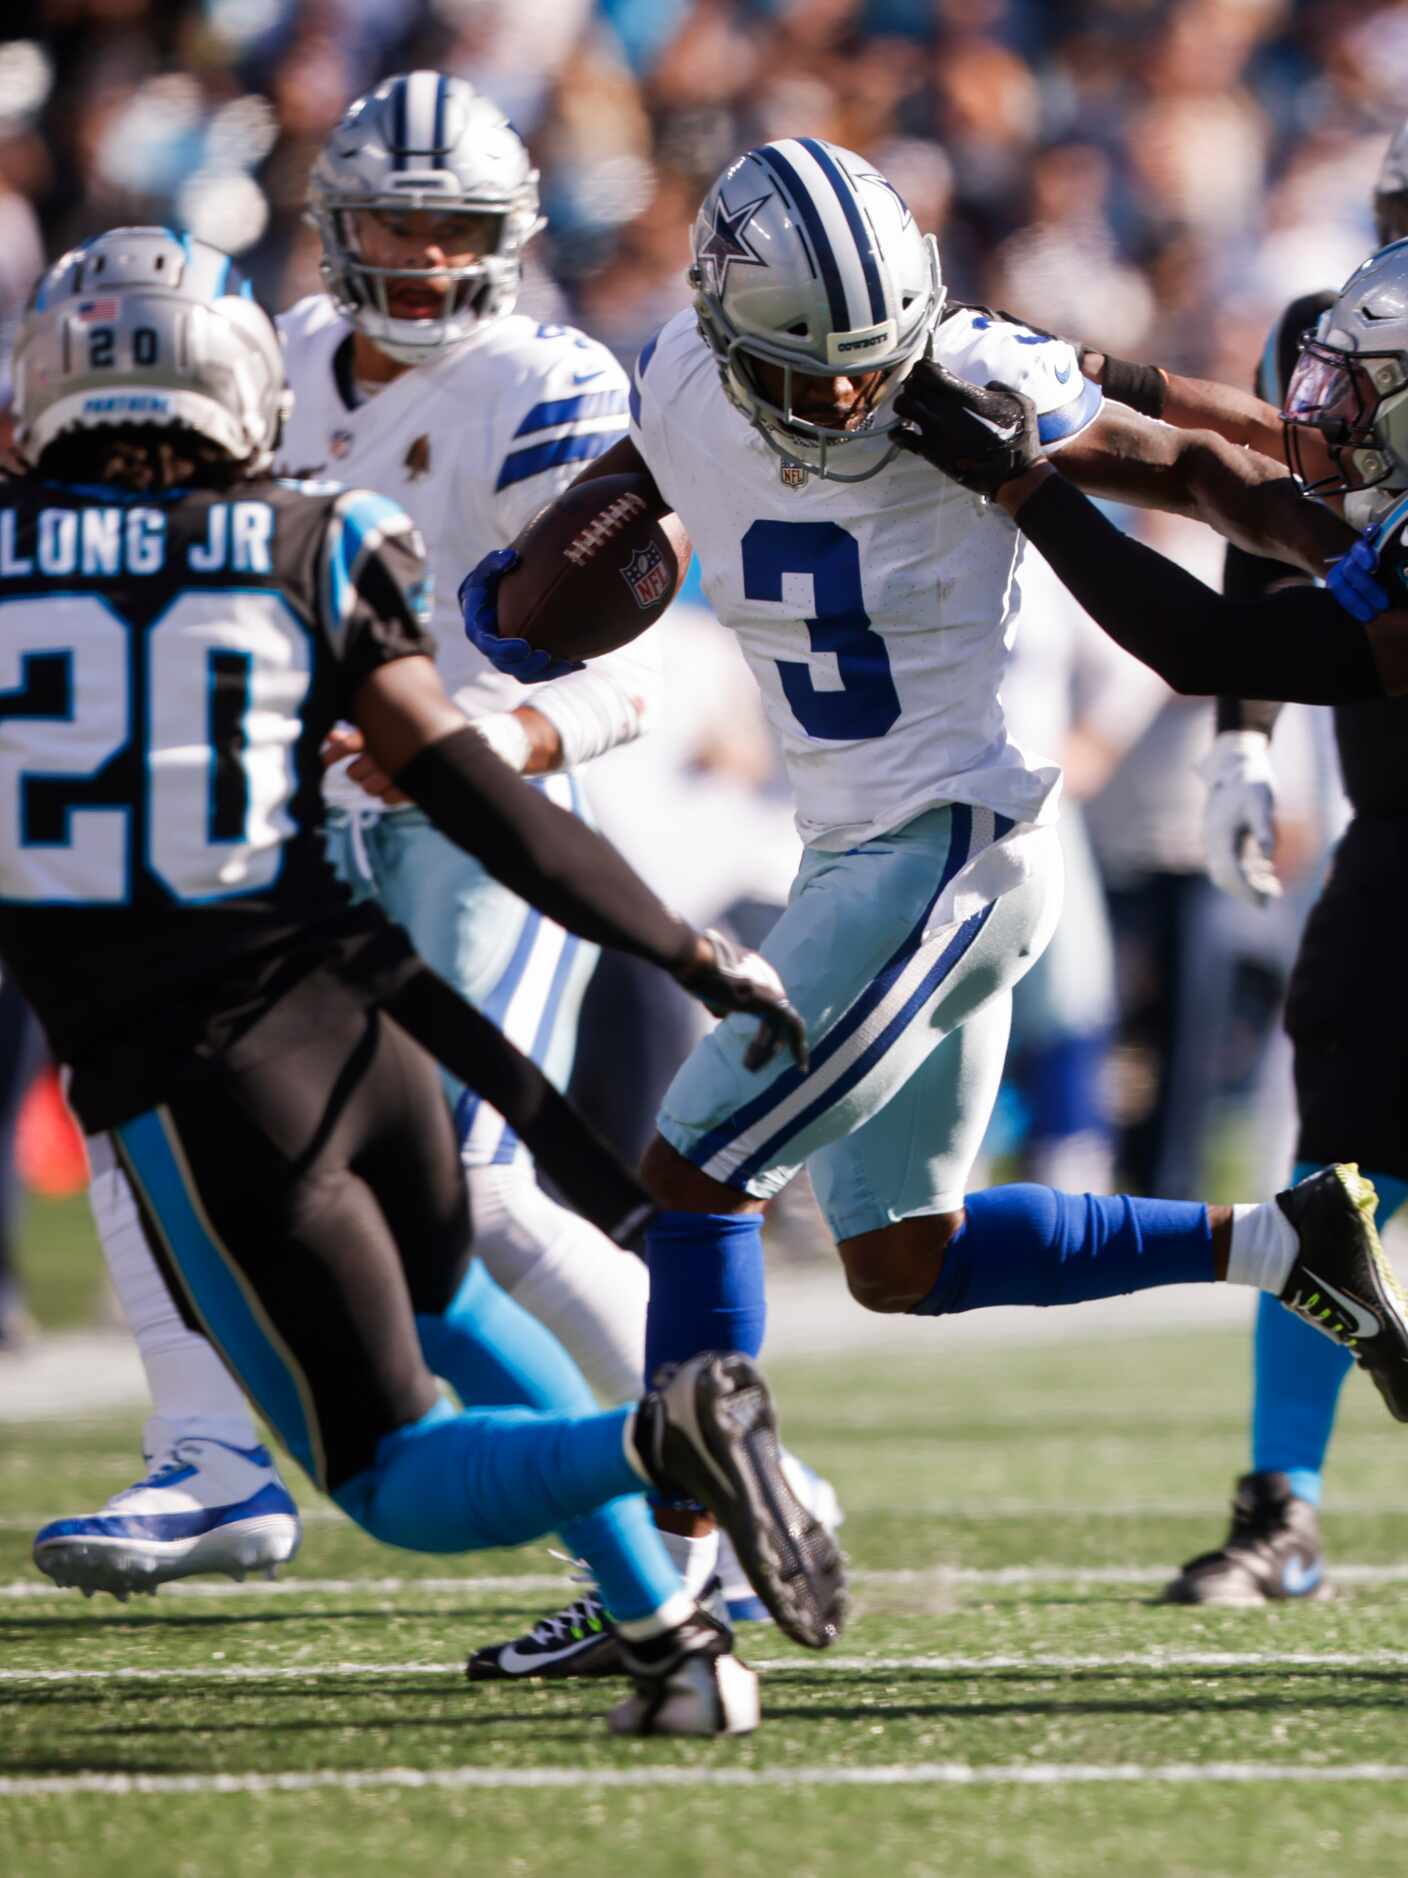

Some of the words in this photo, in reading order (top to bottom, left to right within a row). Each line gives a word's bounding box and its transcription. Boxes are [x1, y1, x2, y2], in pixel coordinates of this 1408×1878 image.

[88, 326, 158, 368] 20
[837, 332, 888, 352] COWBOYS
[0, 506, 167, 577] LONG
[187, 500, 276, 576] JR
[636, 566, 668, 603] NFL
[741, 519, 902, 740] 3
[0, 586, 316, 908] 20
